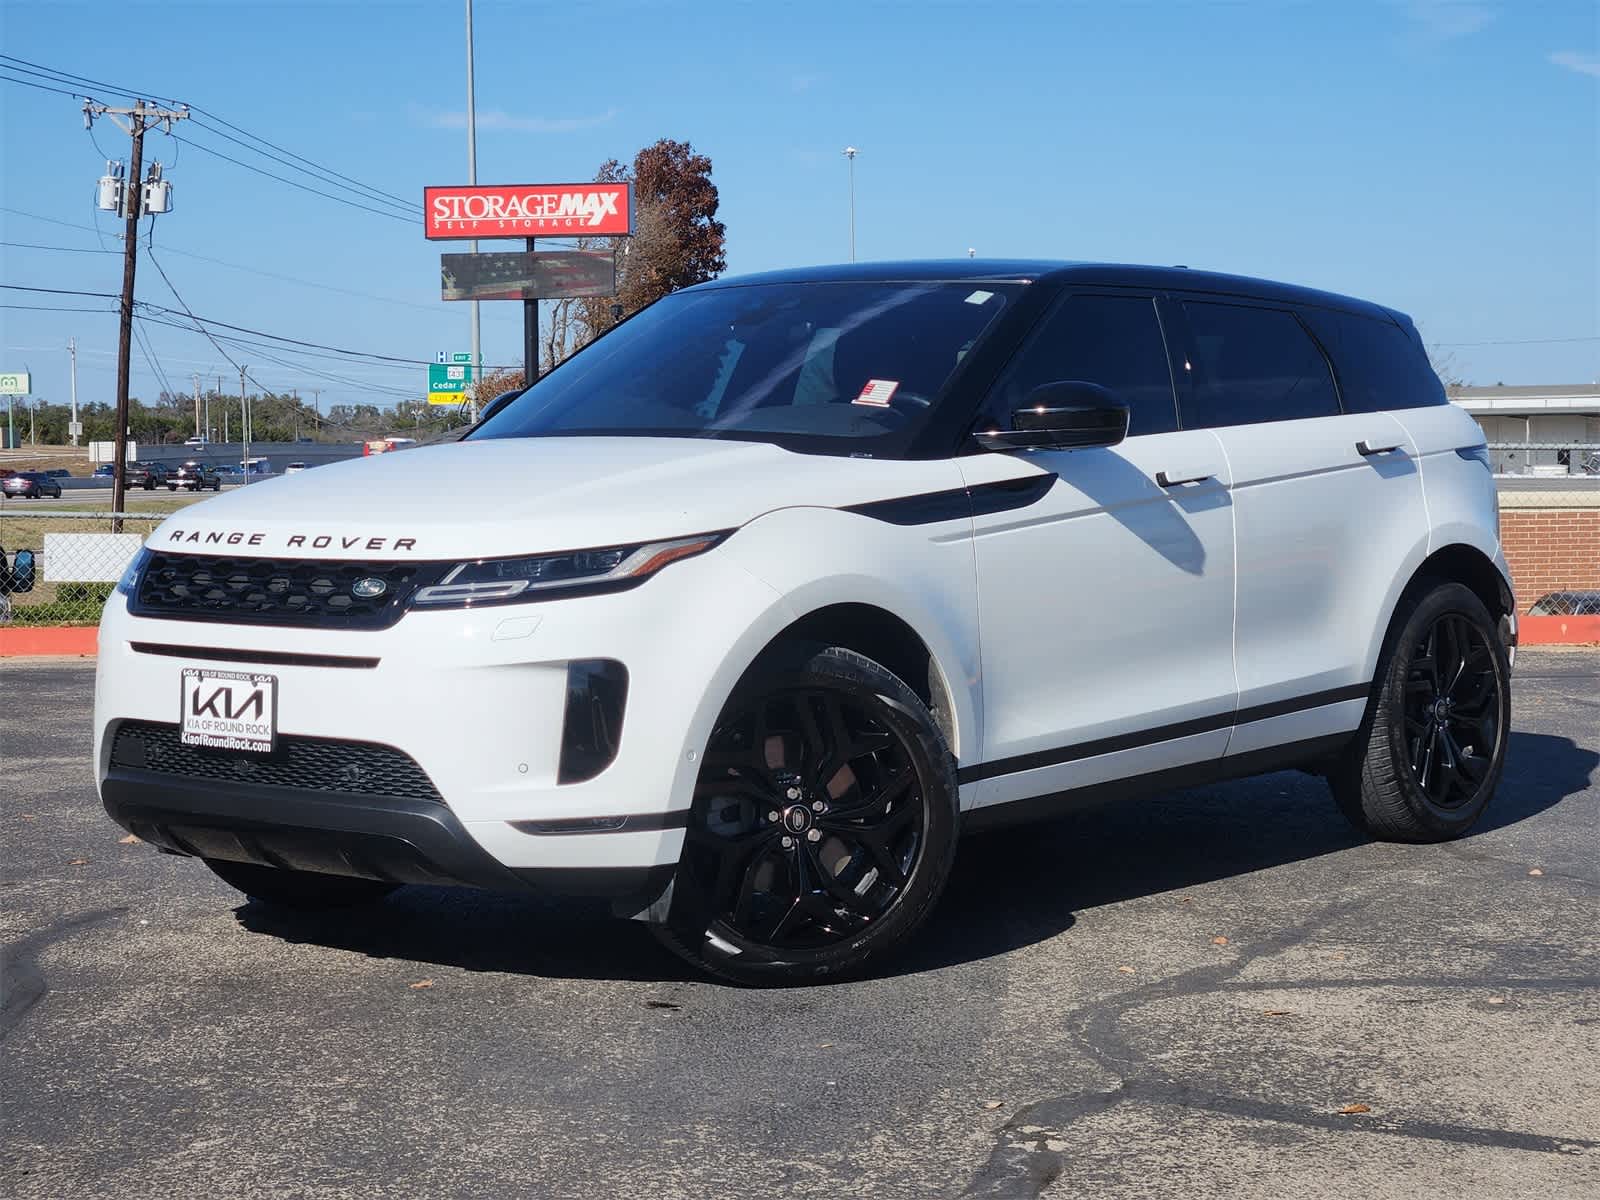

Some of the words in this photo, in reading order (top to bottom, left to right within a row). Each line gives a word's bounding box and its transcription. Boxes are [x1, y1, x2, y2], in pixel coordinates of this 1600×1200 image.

[434, 219, 478, 229] SELF
[499, 218, 585, 228] STORAGE
[169, 530, 266, 546] RANGE
[287, 535, 417, 551] ROVER
[192, 685, 264, 721] KIA
[186, 719, 200, 729] KIA
[201, 721, 212, 730] OF
[214, 722, 245, 734] ROUND
[245, 724, 270, 735] ROCK
[181, 732, 271, 752] KiaofRoundRock.com
